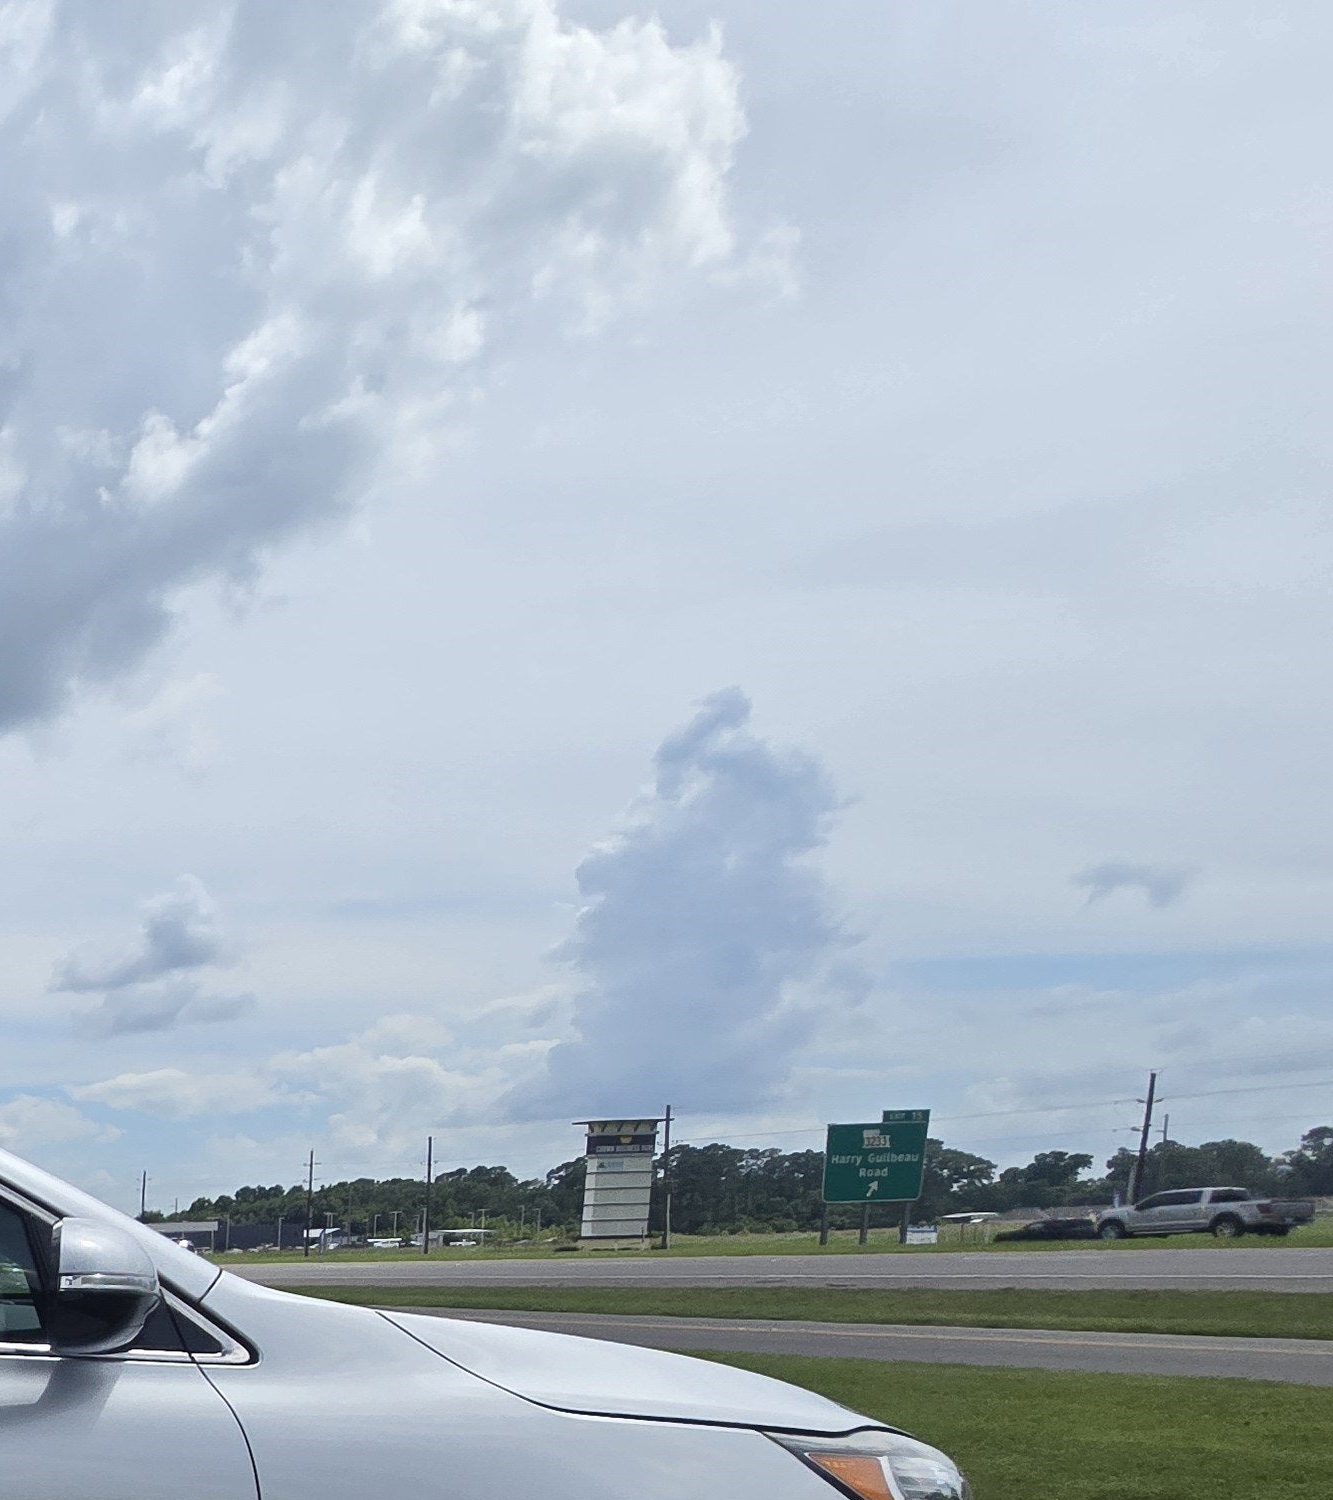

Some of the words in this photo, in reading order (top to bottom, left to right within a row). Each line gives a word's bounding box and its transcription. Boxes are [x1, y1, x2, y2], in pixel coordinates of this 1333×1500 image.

[831, 1154, 863, 1166] Harry
[868, 1153, 919, 1164] Guilbeau
[859, 1167, 888, 1177] Road
